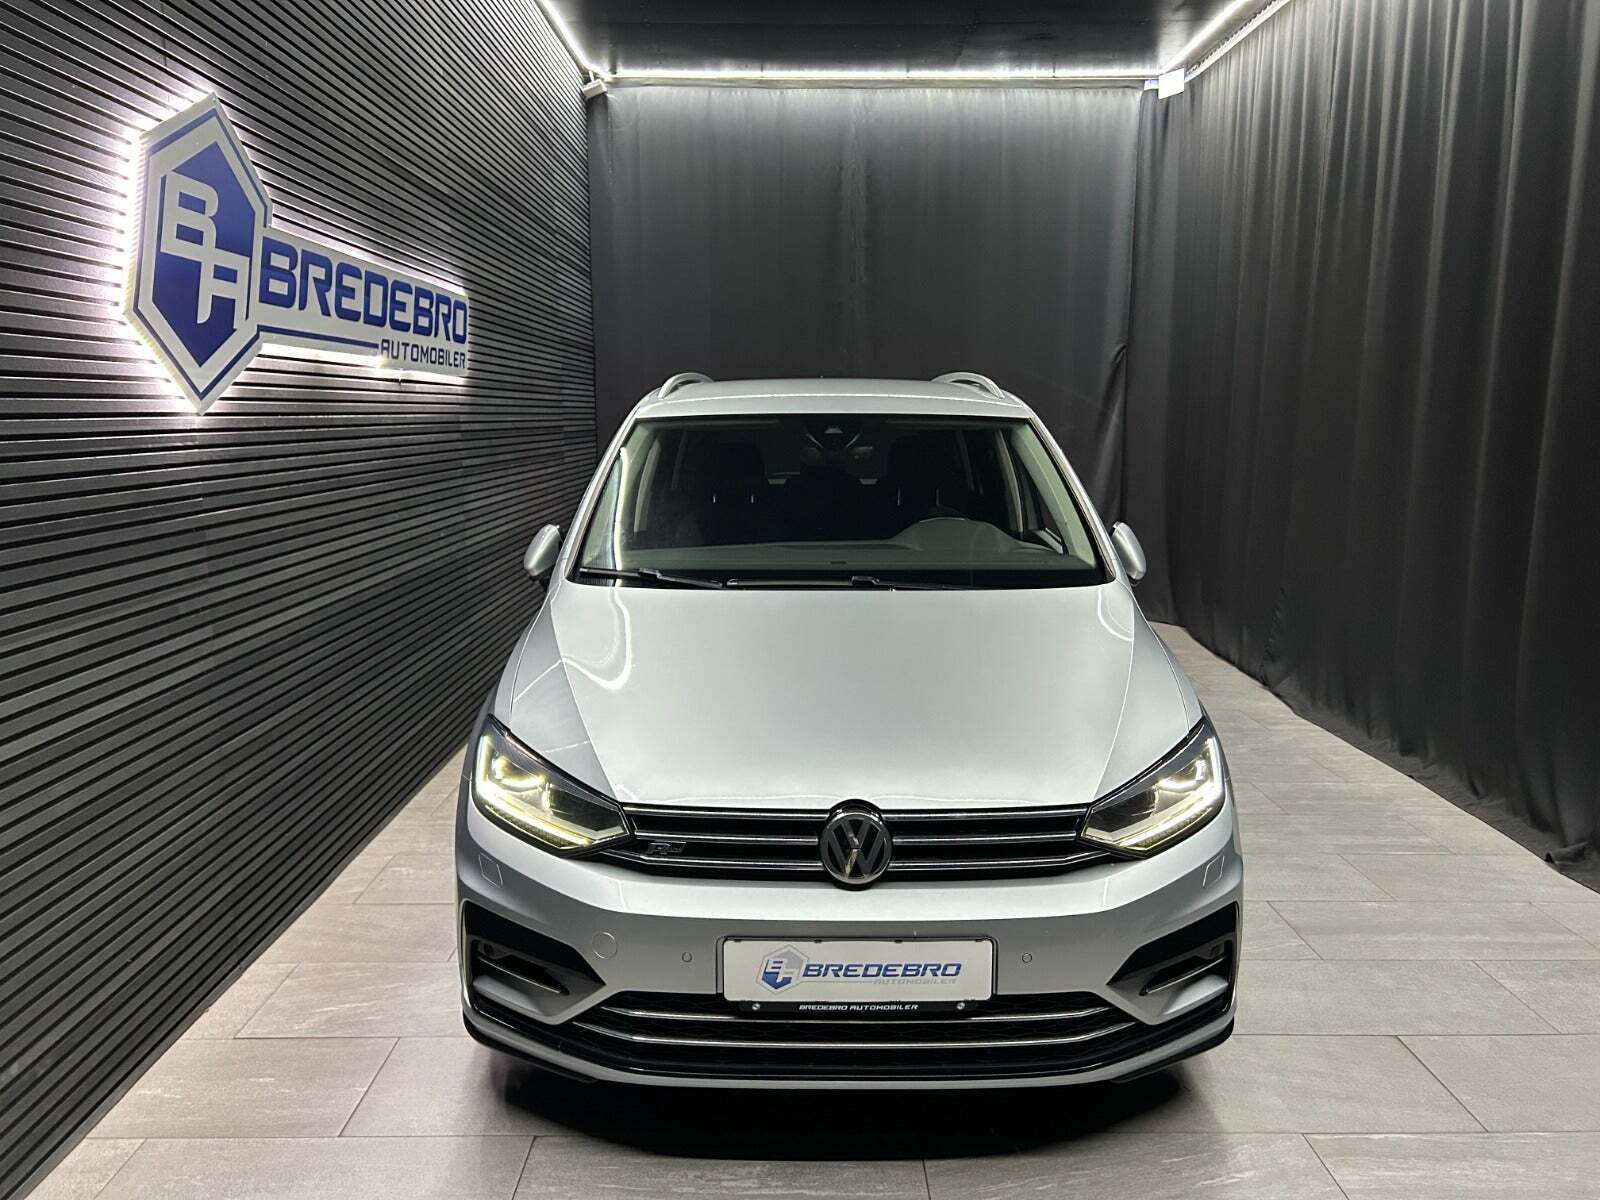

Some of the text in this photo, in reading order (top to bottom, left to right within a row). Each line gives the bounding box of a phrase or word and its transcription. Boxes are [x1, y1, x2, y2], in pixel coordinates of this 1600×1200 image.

[258, 235, 467, 344] BREDEBRO
[381, 338, 466, 369] AUTOMOBILER
[802, 963, 962, 978] BREDEBRO
